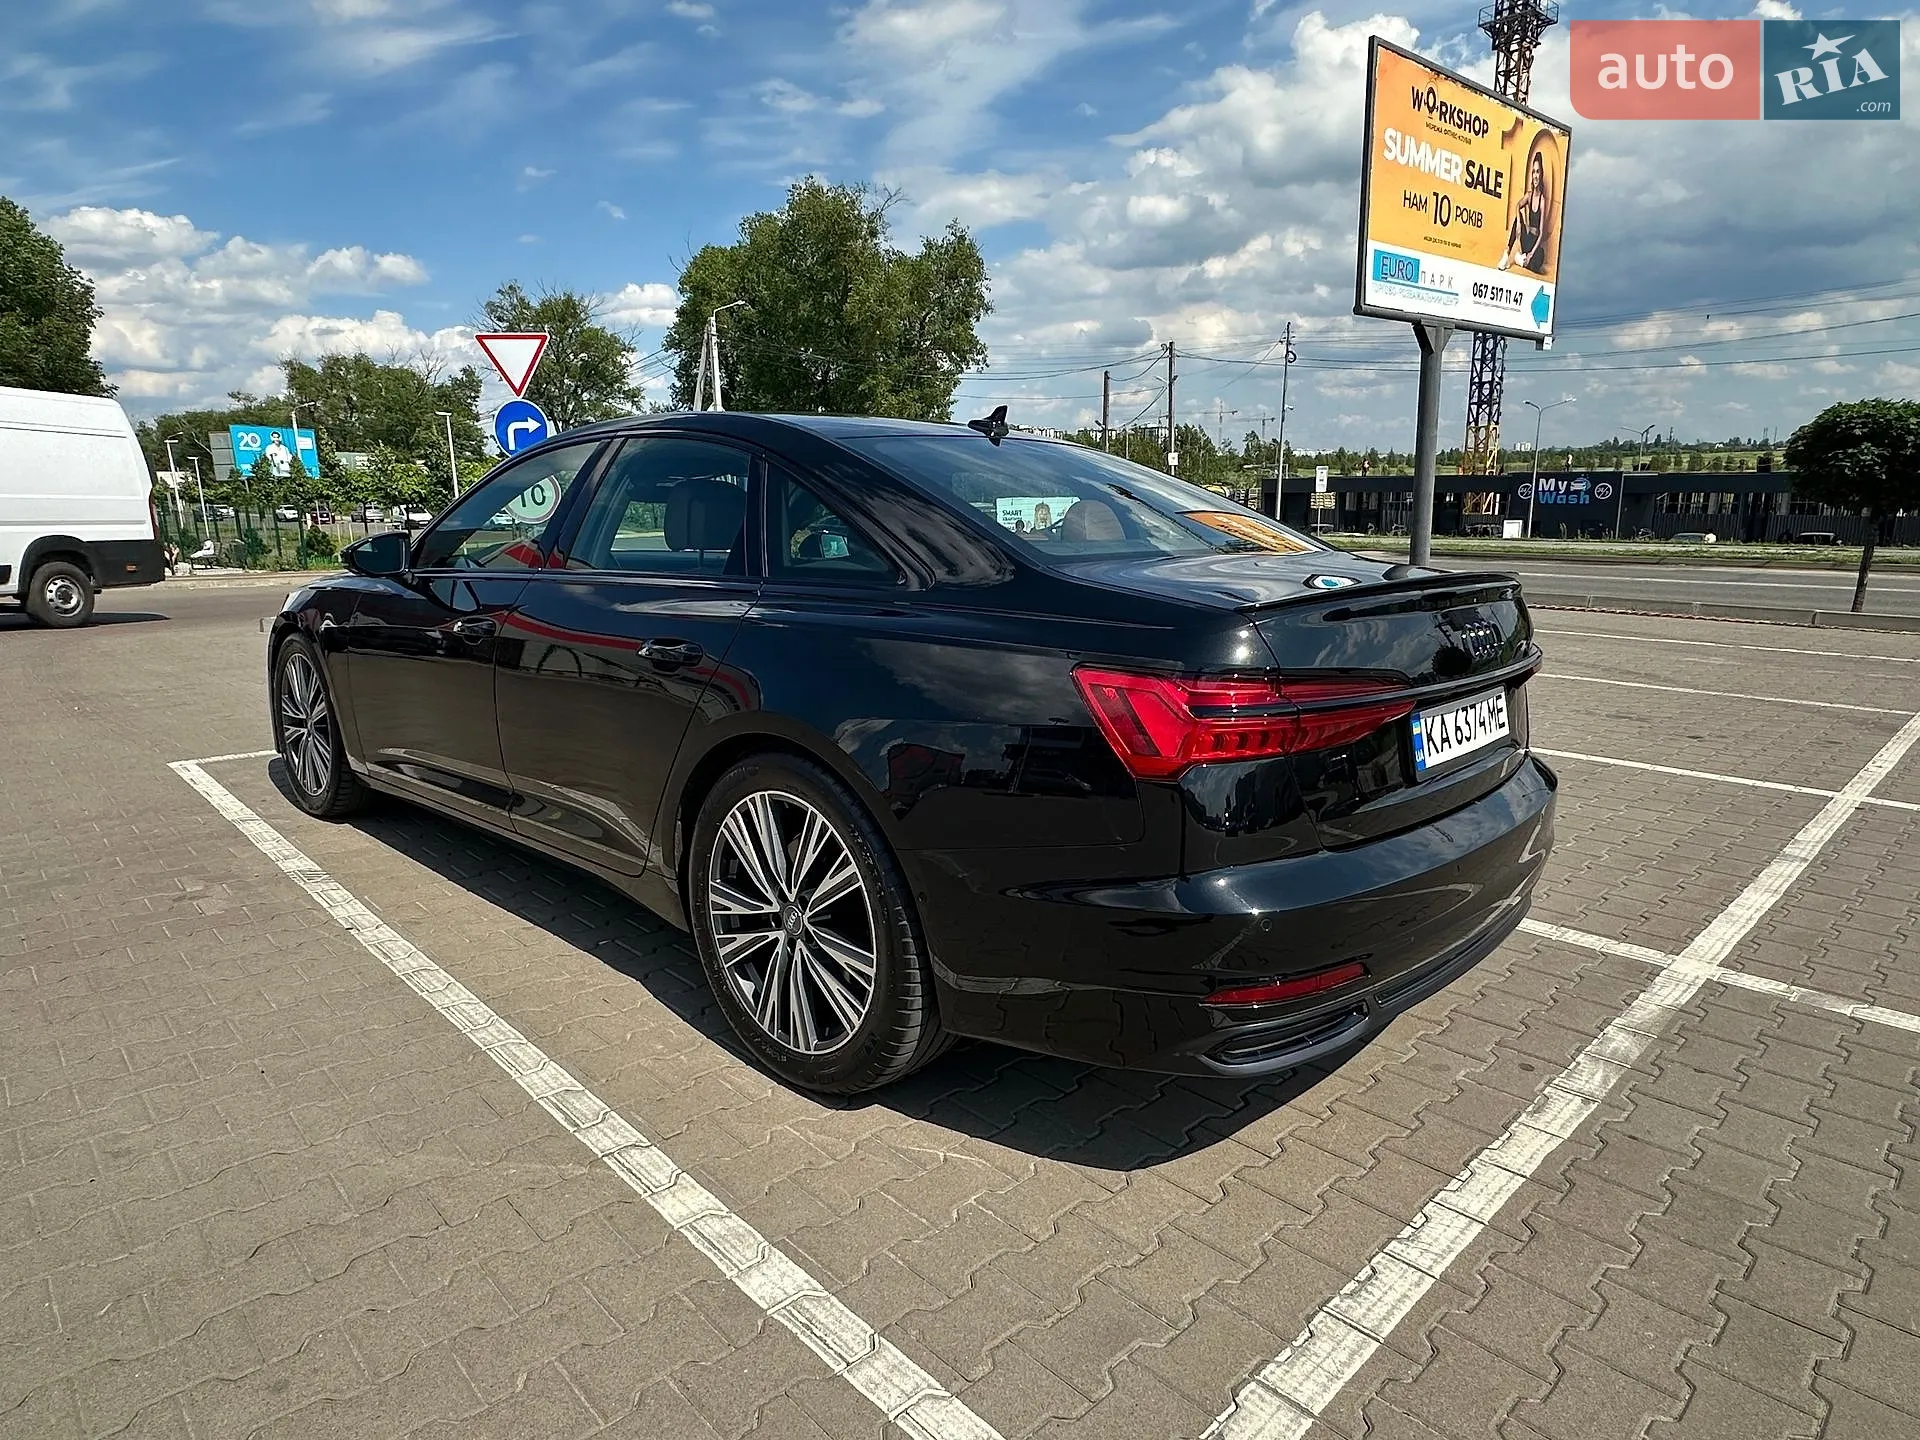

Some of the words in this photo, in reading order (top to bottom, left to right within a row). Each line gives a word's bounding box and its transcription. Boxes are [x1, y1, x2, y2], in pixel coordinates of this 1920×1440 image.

[1412, 86, 1489, 138] WORKSHOP
[1383, 127, 1463, 185] SUMMER
[1465, 160, 1503, 199] SALE
[1403, 190, 1428, 213] НАМ
[1433, 191, 1452, 228] 10
[1455, 205, 1483, 229] РОКІВ
[1381, 255, 1414, 281] EURO
[1473, 282, 1488, 299] 067
[1490, 286, 1503, 302] 517
[1506, 289, 1511, 304] 11
[1513, 292, 1523, 306] 47
[238, 432, 261, 448] 20
[1538, 478, 1568, 494] My
[1538, 491, 1590, 504] Wash
[1002, 509, 1022, 517] SMART
[1424, 714, 1452, 757] KA
